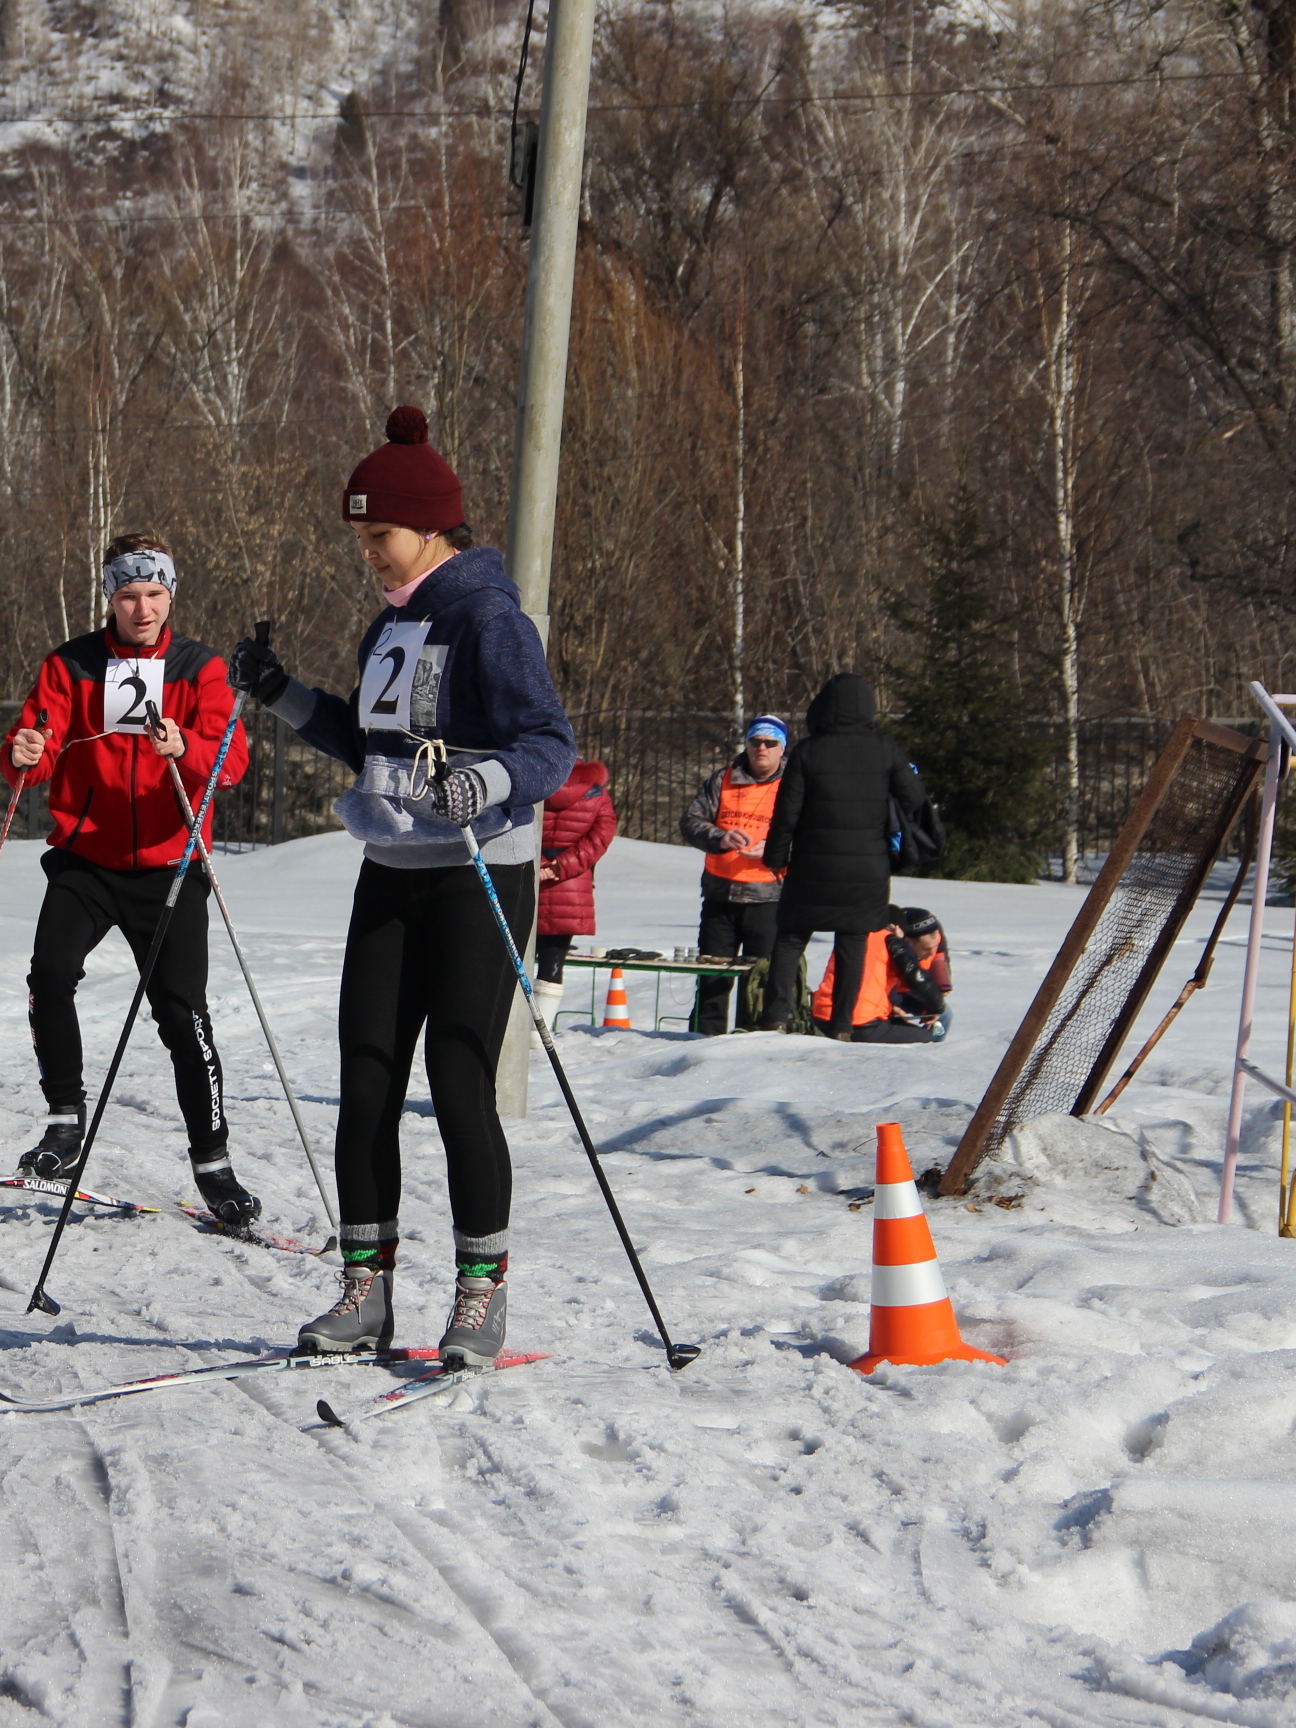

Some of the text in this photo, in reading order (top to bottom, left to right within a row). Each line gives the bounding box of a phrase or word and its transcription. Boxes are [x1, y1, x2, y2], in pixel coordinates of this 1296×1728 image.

[372, 627, 393, 656] 2
[370, 646, 406, 715] 2
[115, 676, 148, 726] 2
[189, 771, 218, 845] SPORT ENERGY
[493, 898, 508, 927] SPORT
[207, 1065, 221, 1131] SOCIETY
[24, 1180, 67, 1195] SALOMON
[309, 1353, 359, 1367] SABLE
